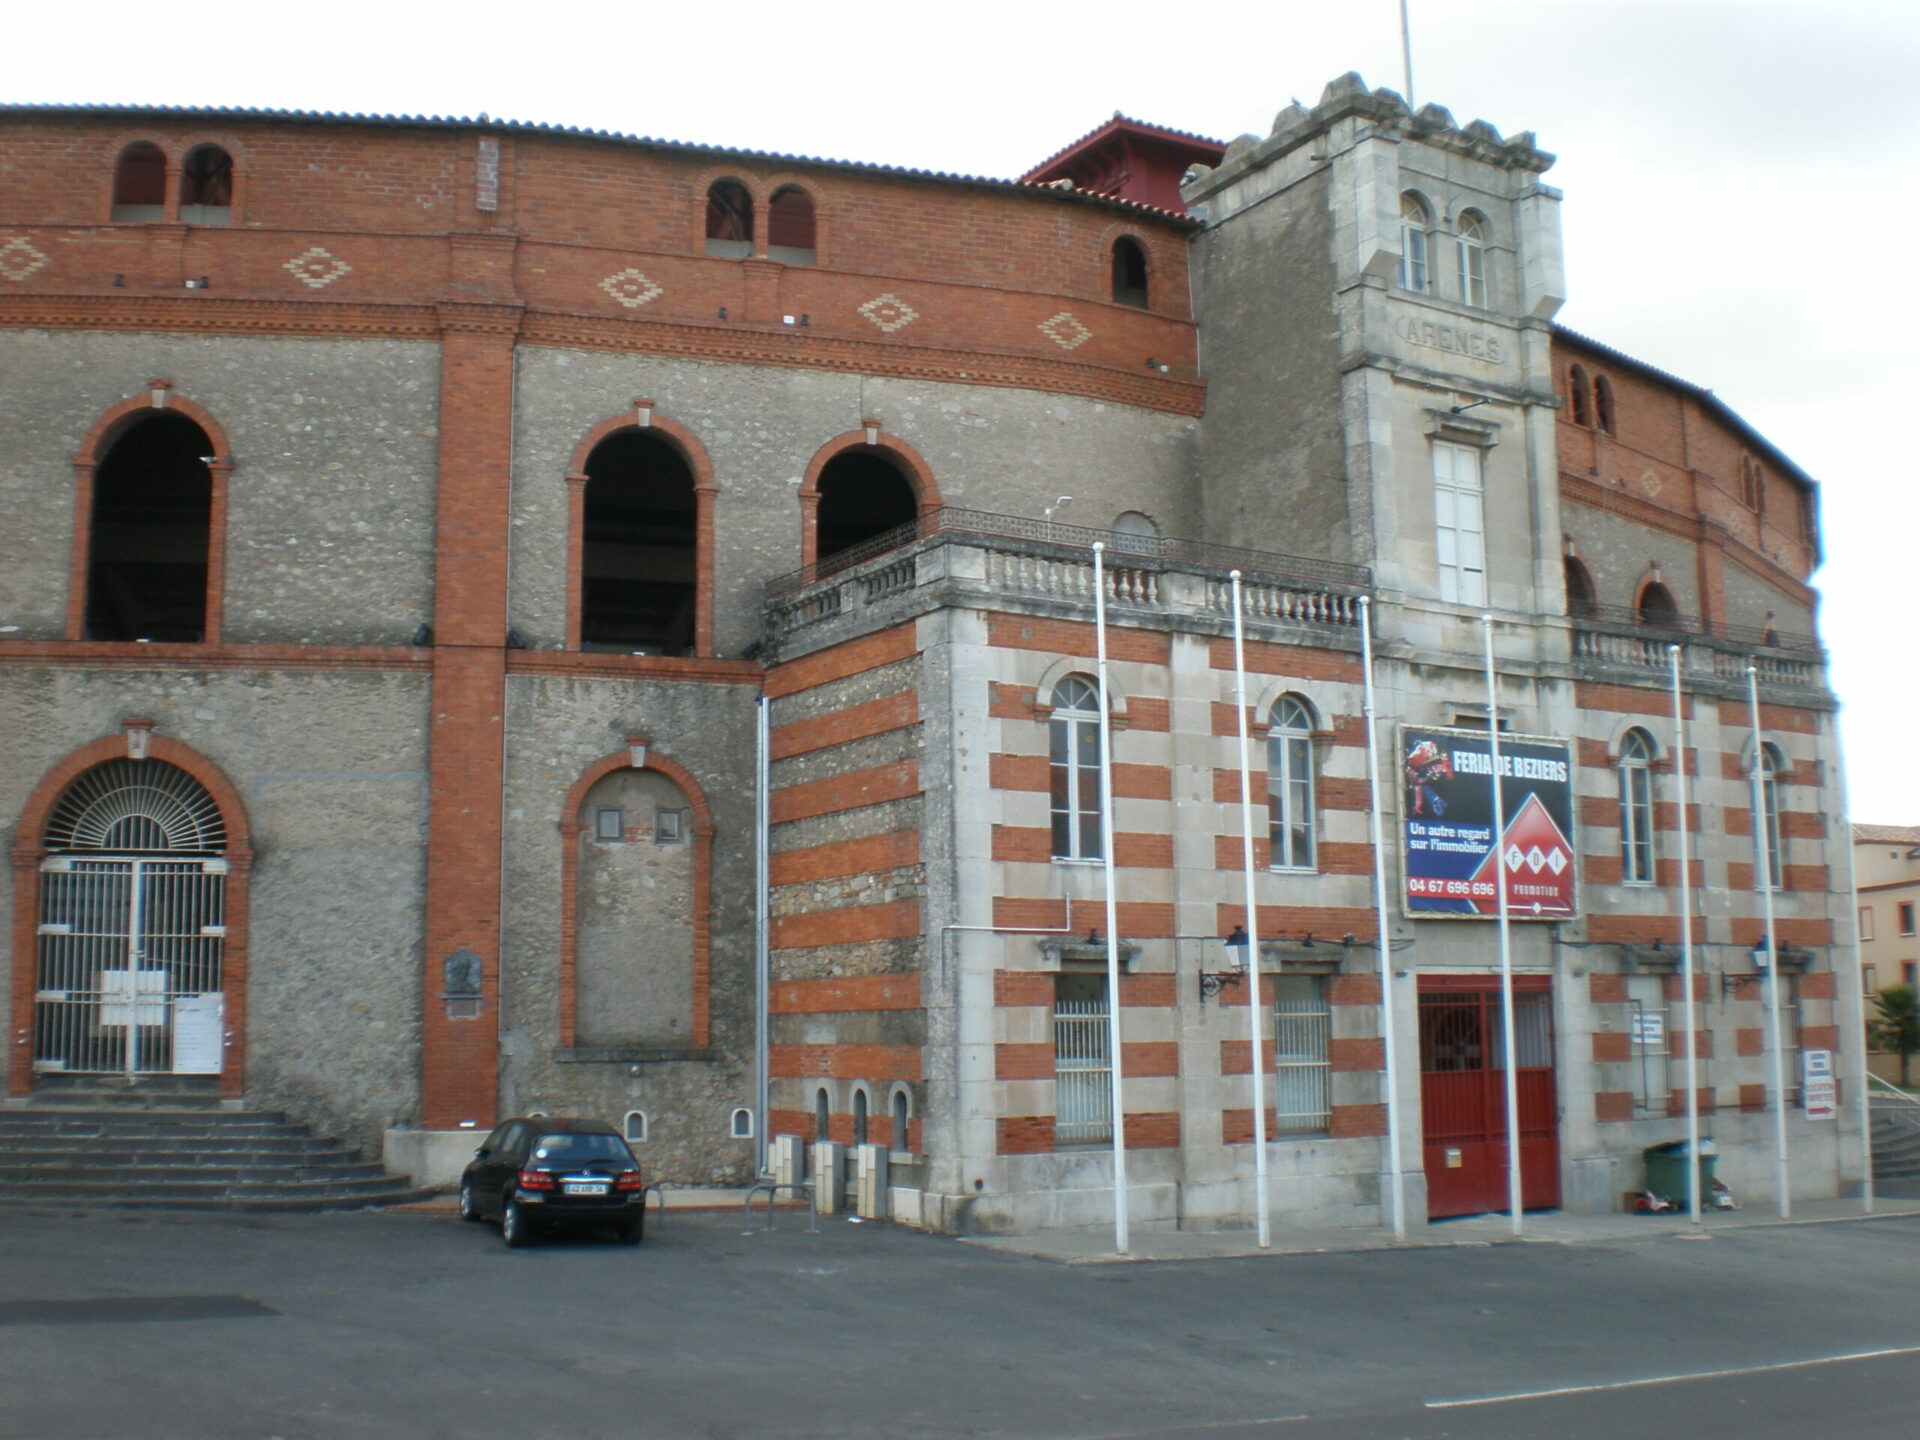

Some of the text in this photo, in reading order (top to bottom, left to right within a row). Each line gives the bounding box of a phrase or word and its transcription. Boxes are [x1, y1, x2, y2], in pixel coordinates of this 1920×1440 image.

[1407, 319, 1501, 360] ARENES
[1453, 751, 1567, 782] FERIA DE BEZIERS
[1410, 823, 1490, 841] Un autre regard
[1410, 839, 1489, 853] sur l'immobilier
[1409, 879, 1495, 895] 04 67 696 696
[1513, 884, 1559, 897] PROMOTION
